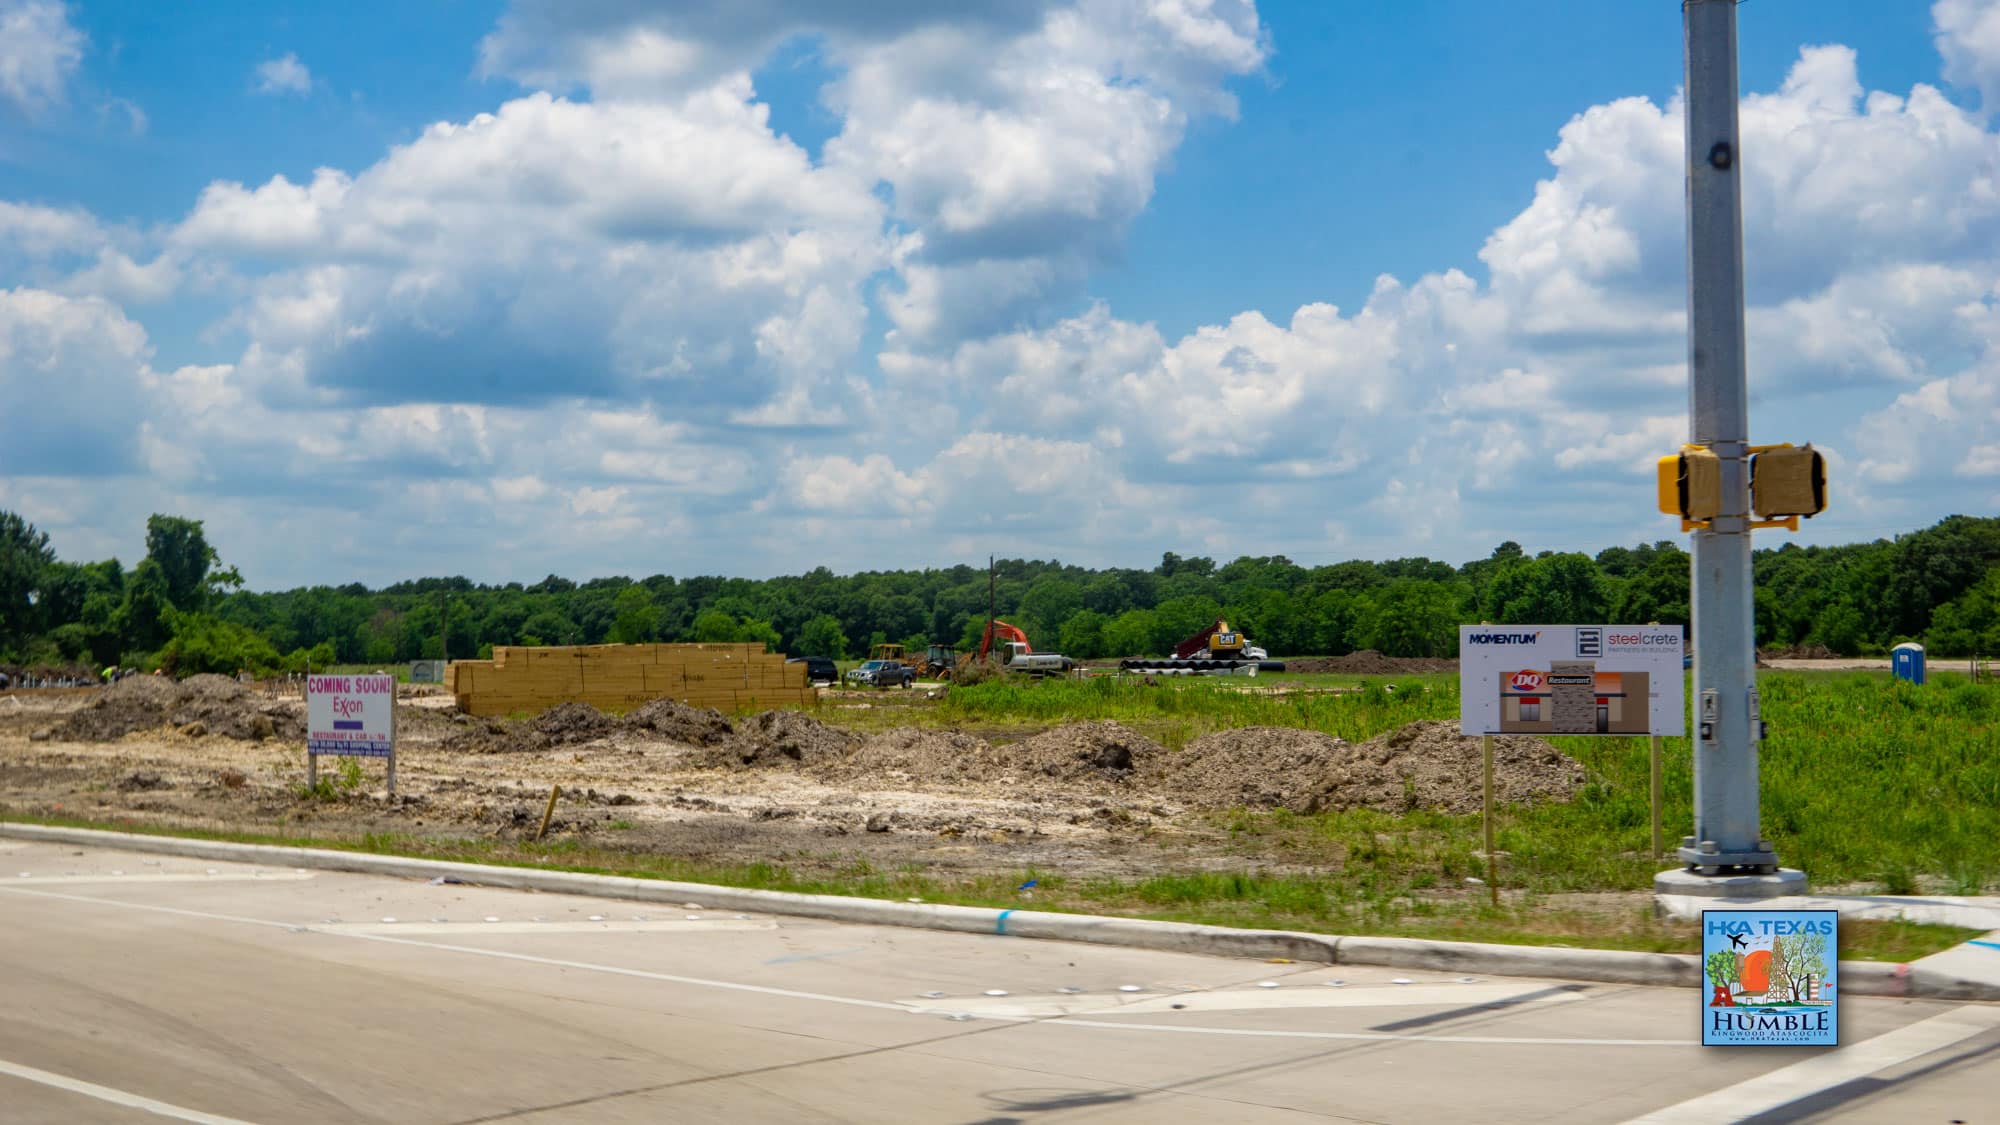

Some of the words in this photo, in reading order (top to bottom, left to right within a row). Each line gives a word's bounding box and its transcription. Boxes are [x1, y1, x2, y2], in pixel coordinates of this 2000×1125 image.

[1220, 634, 1235, 644] CAT
[1469, 634, 1536, 644] MOMENTUM
[1608, 631, 1678, 645] steelcrete
[309, 677, 350, 693] COMING
[355, 677, 390, 693] SOON!
[1517, 674, 1539, 687] DQ
[1549, 676, 1590, 684] Restaurant
[333, 696, 363, 719] Exxon
[312, 731, 347, 740] RESTAURANT
